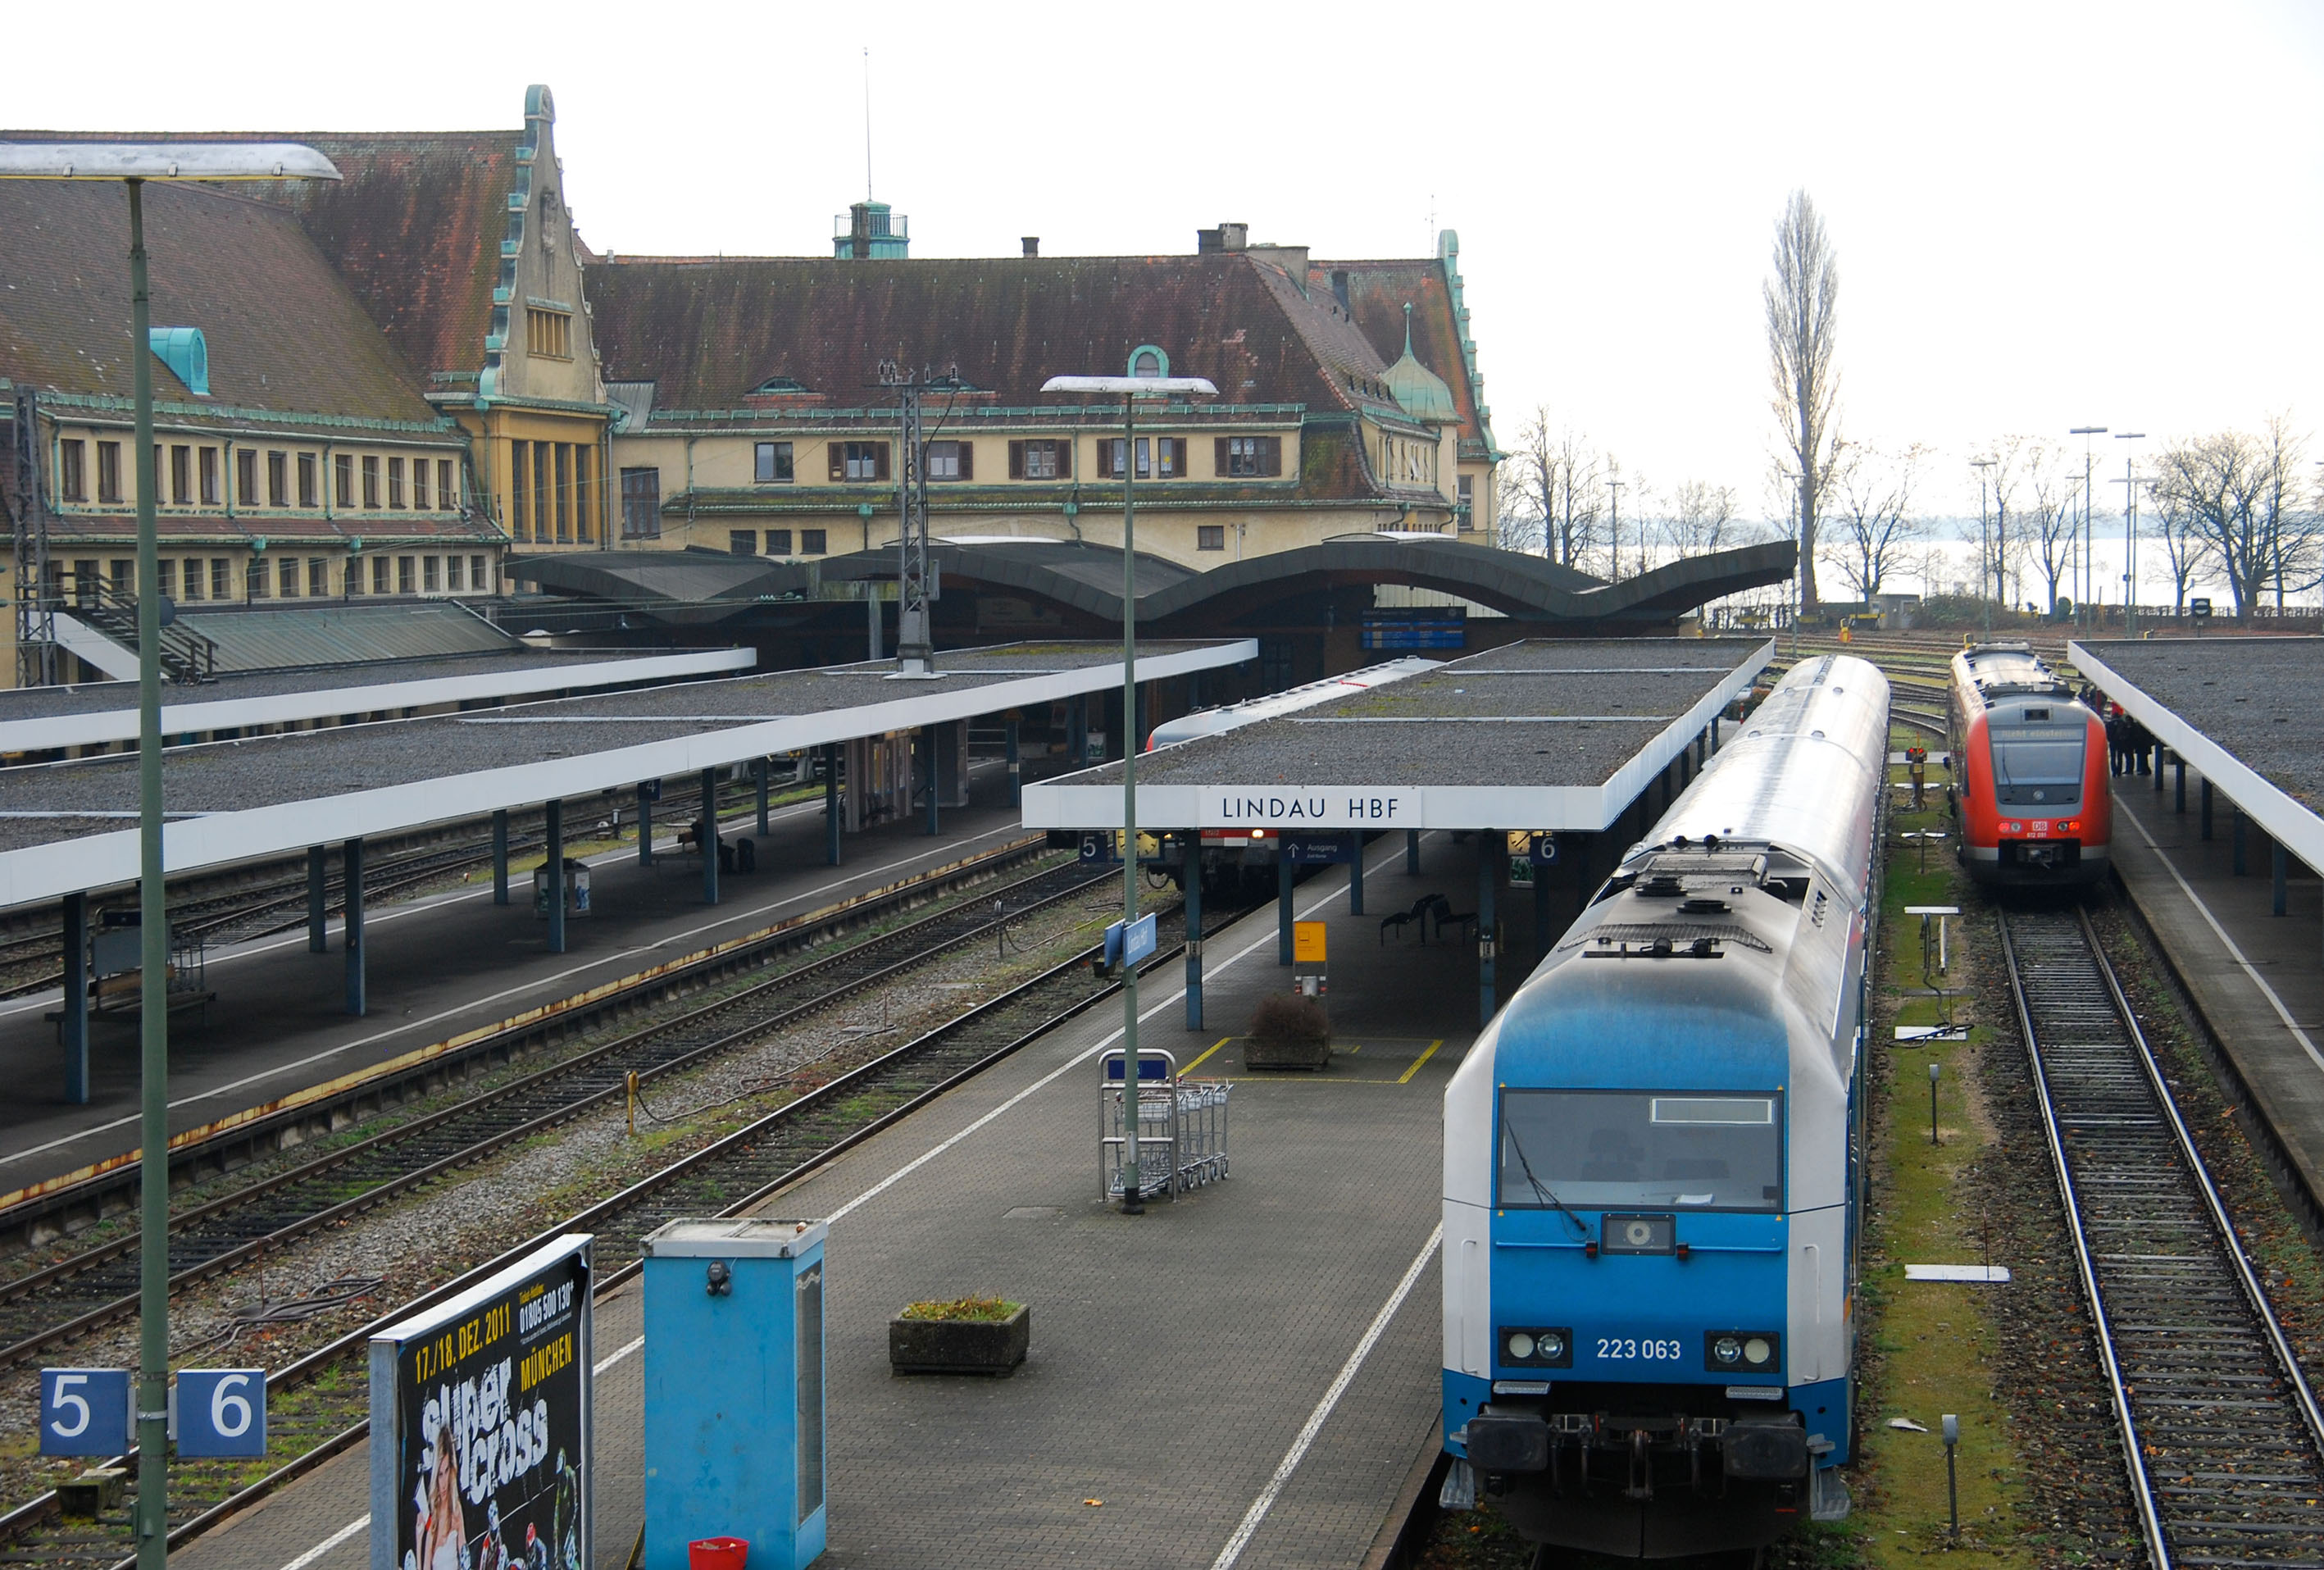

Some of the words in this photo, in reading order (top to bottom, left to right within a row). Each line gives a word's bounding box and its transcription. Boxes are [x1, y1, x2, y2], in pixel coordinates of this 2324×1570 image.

[647, 780, 657, 793] 4
[1222, 798, 1326, 818] LINDAU
[1348, 798, 1398, 818] HBF
[2033, 821, 2047, 831] DB
[1083, 836, 1097, 858] 5
[1307, 844, 1338, 853] Ausgang
[1541, 837, 1556, 859] 6
[519, 1298, 543, 1335] 01805
[542, 1290, 557, 1321] 500
[416, 1334, 457, 1385] 17./18.
[457, 1318, 484, 1361] DEZ.
[485, 1302, 511, 1345] 2011
[1596, 1338, 1637, 1359] 223
[1641, 1339, 1681, 1360] 063
[521, 1331, 573, 1393] MÜNCHEN
[50, 1374, 91, 1438] 5
[210, 1373, 252, 1438] 6
